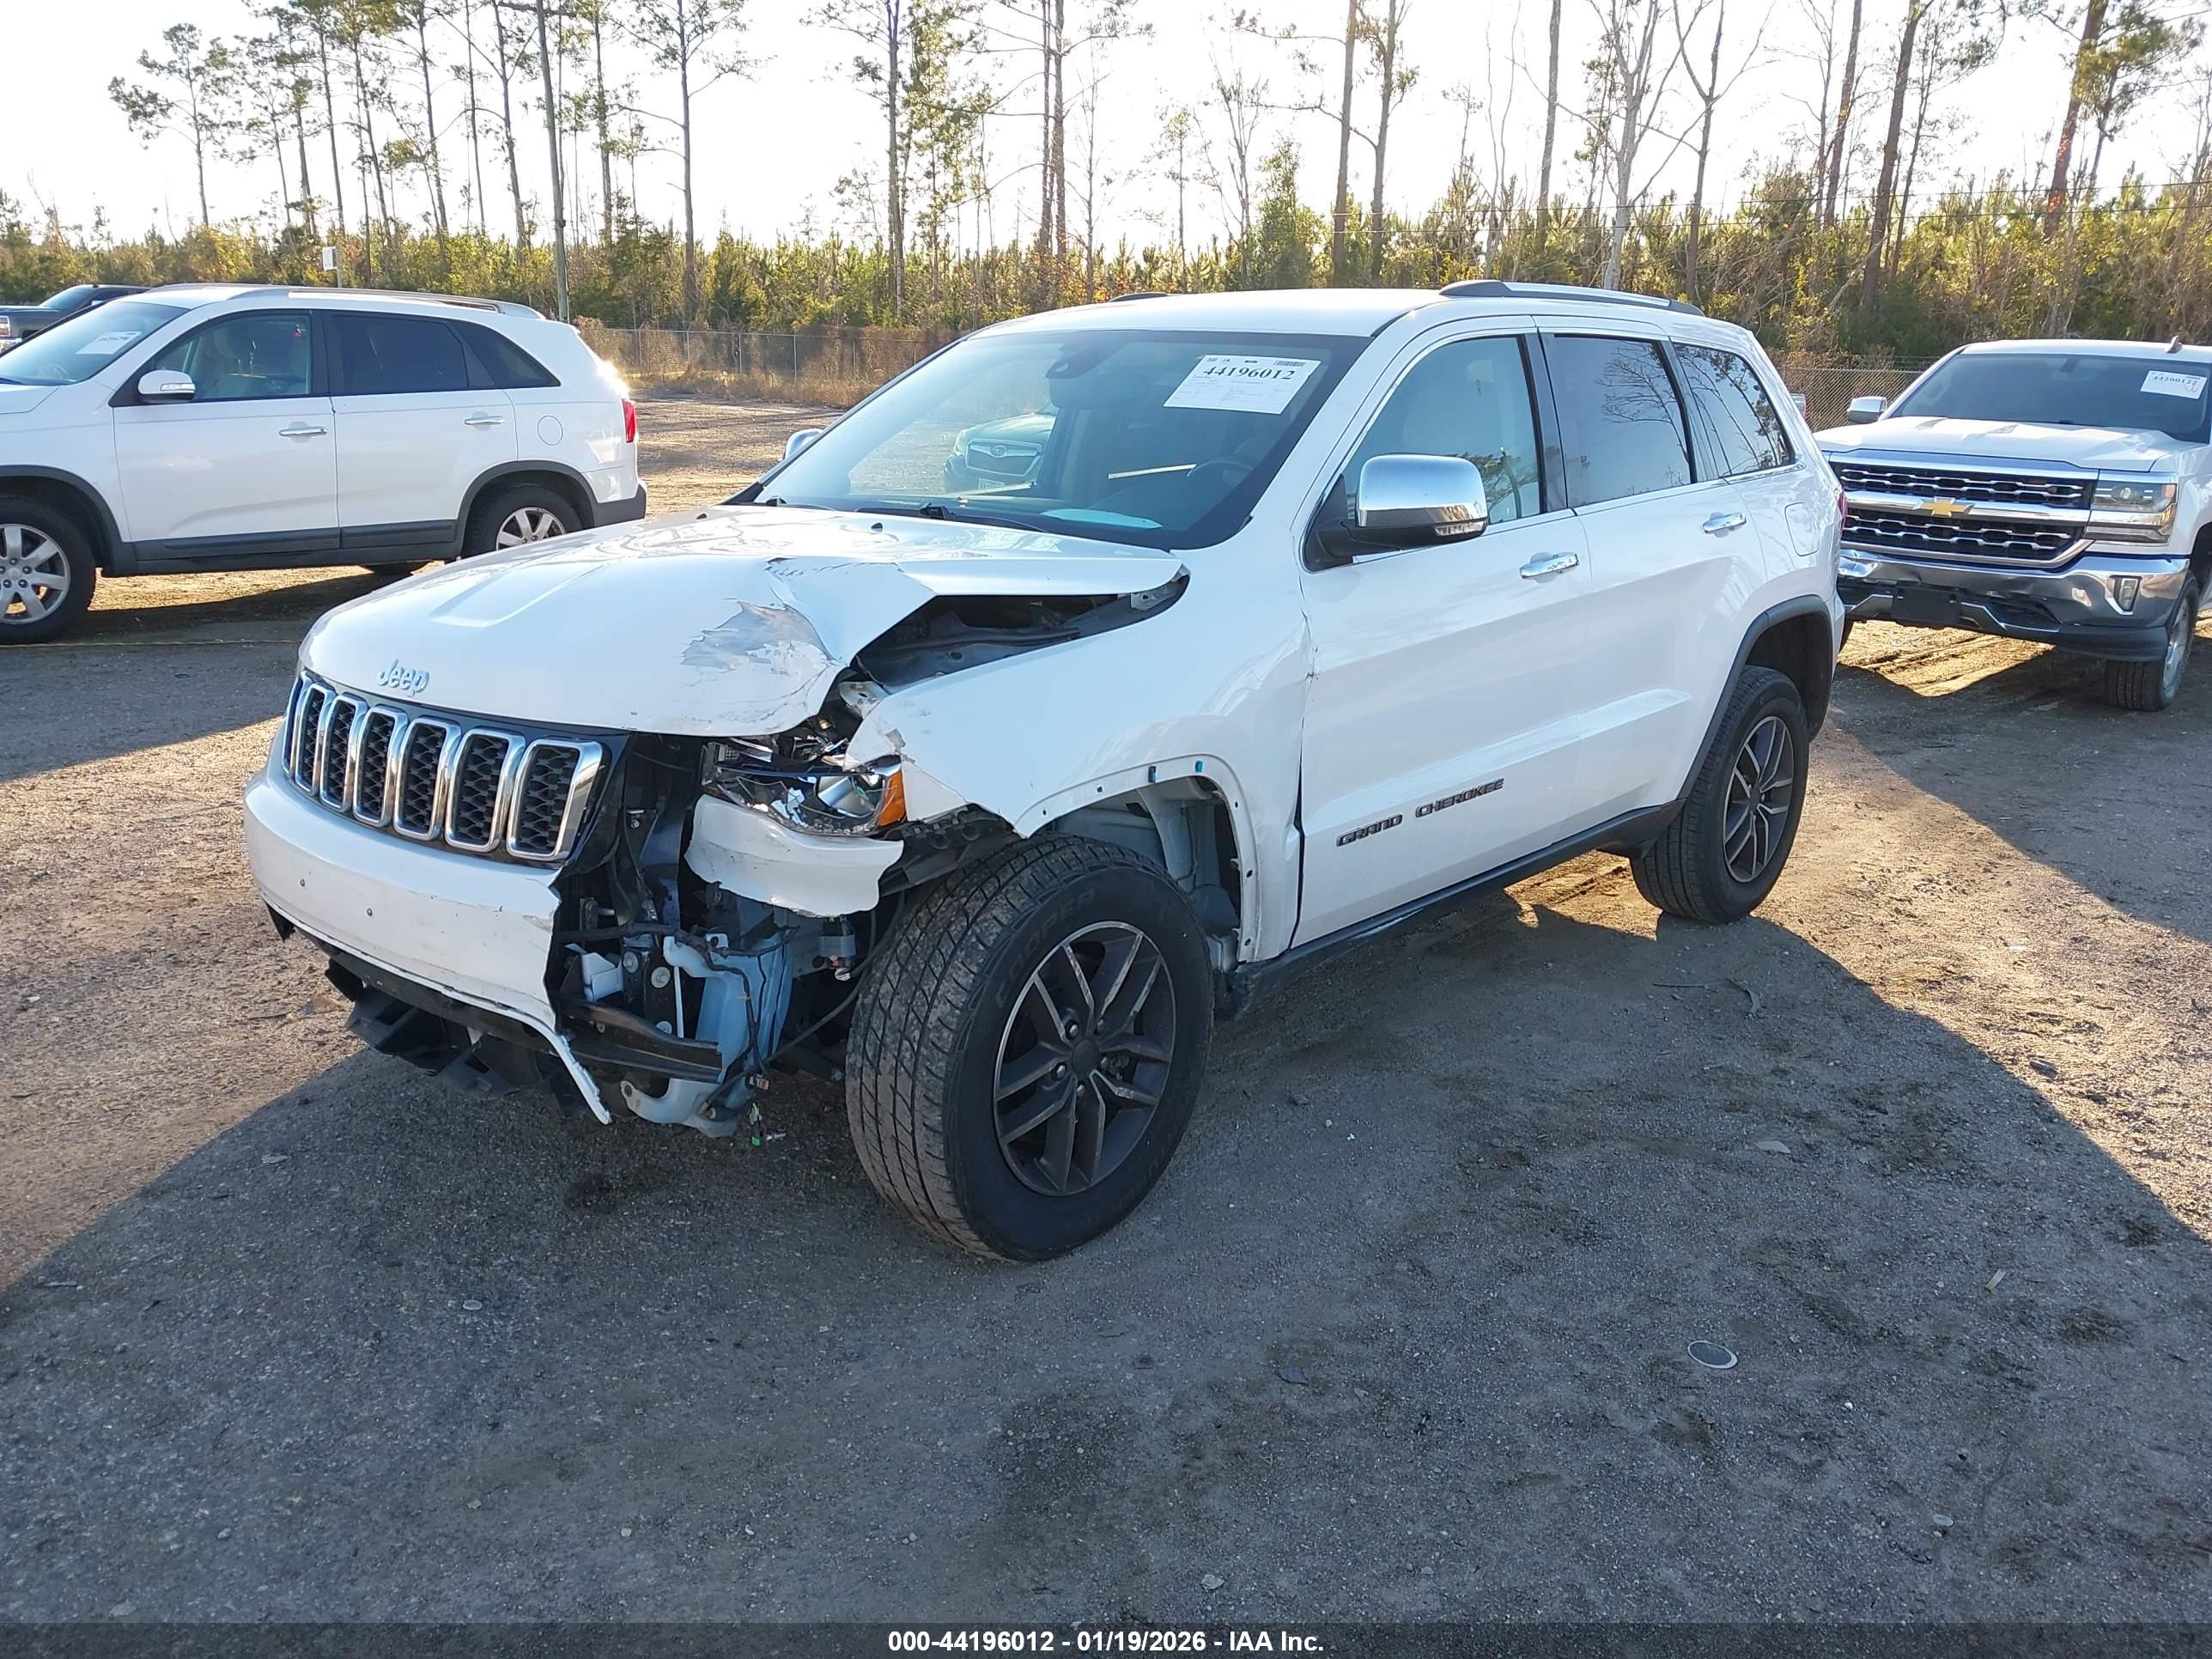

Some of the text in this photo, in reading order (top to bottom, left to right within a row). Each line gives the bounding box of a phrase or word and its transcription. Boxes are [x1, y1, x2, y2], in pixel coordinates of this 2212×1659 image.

[1203, 366, 1296, 380] 44196012
[2151, 375, 2198, 386] 44200122
[377, 659, 430, 697] Jeep
[1336, 778, 1504, 847] GRAND CHEROKEE
[994, 887, 1096, 1009] COOPER
